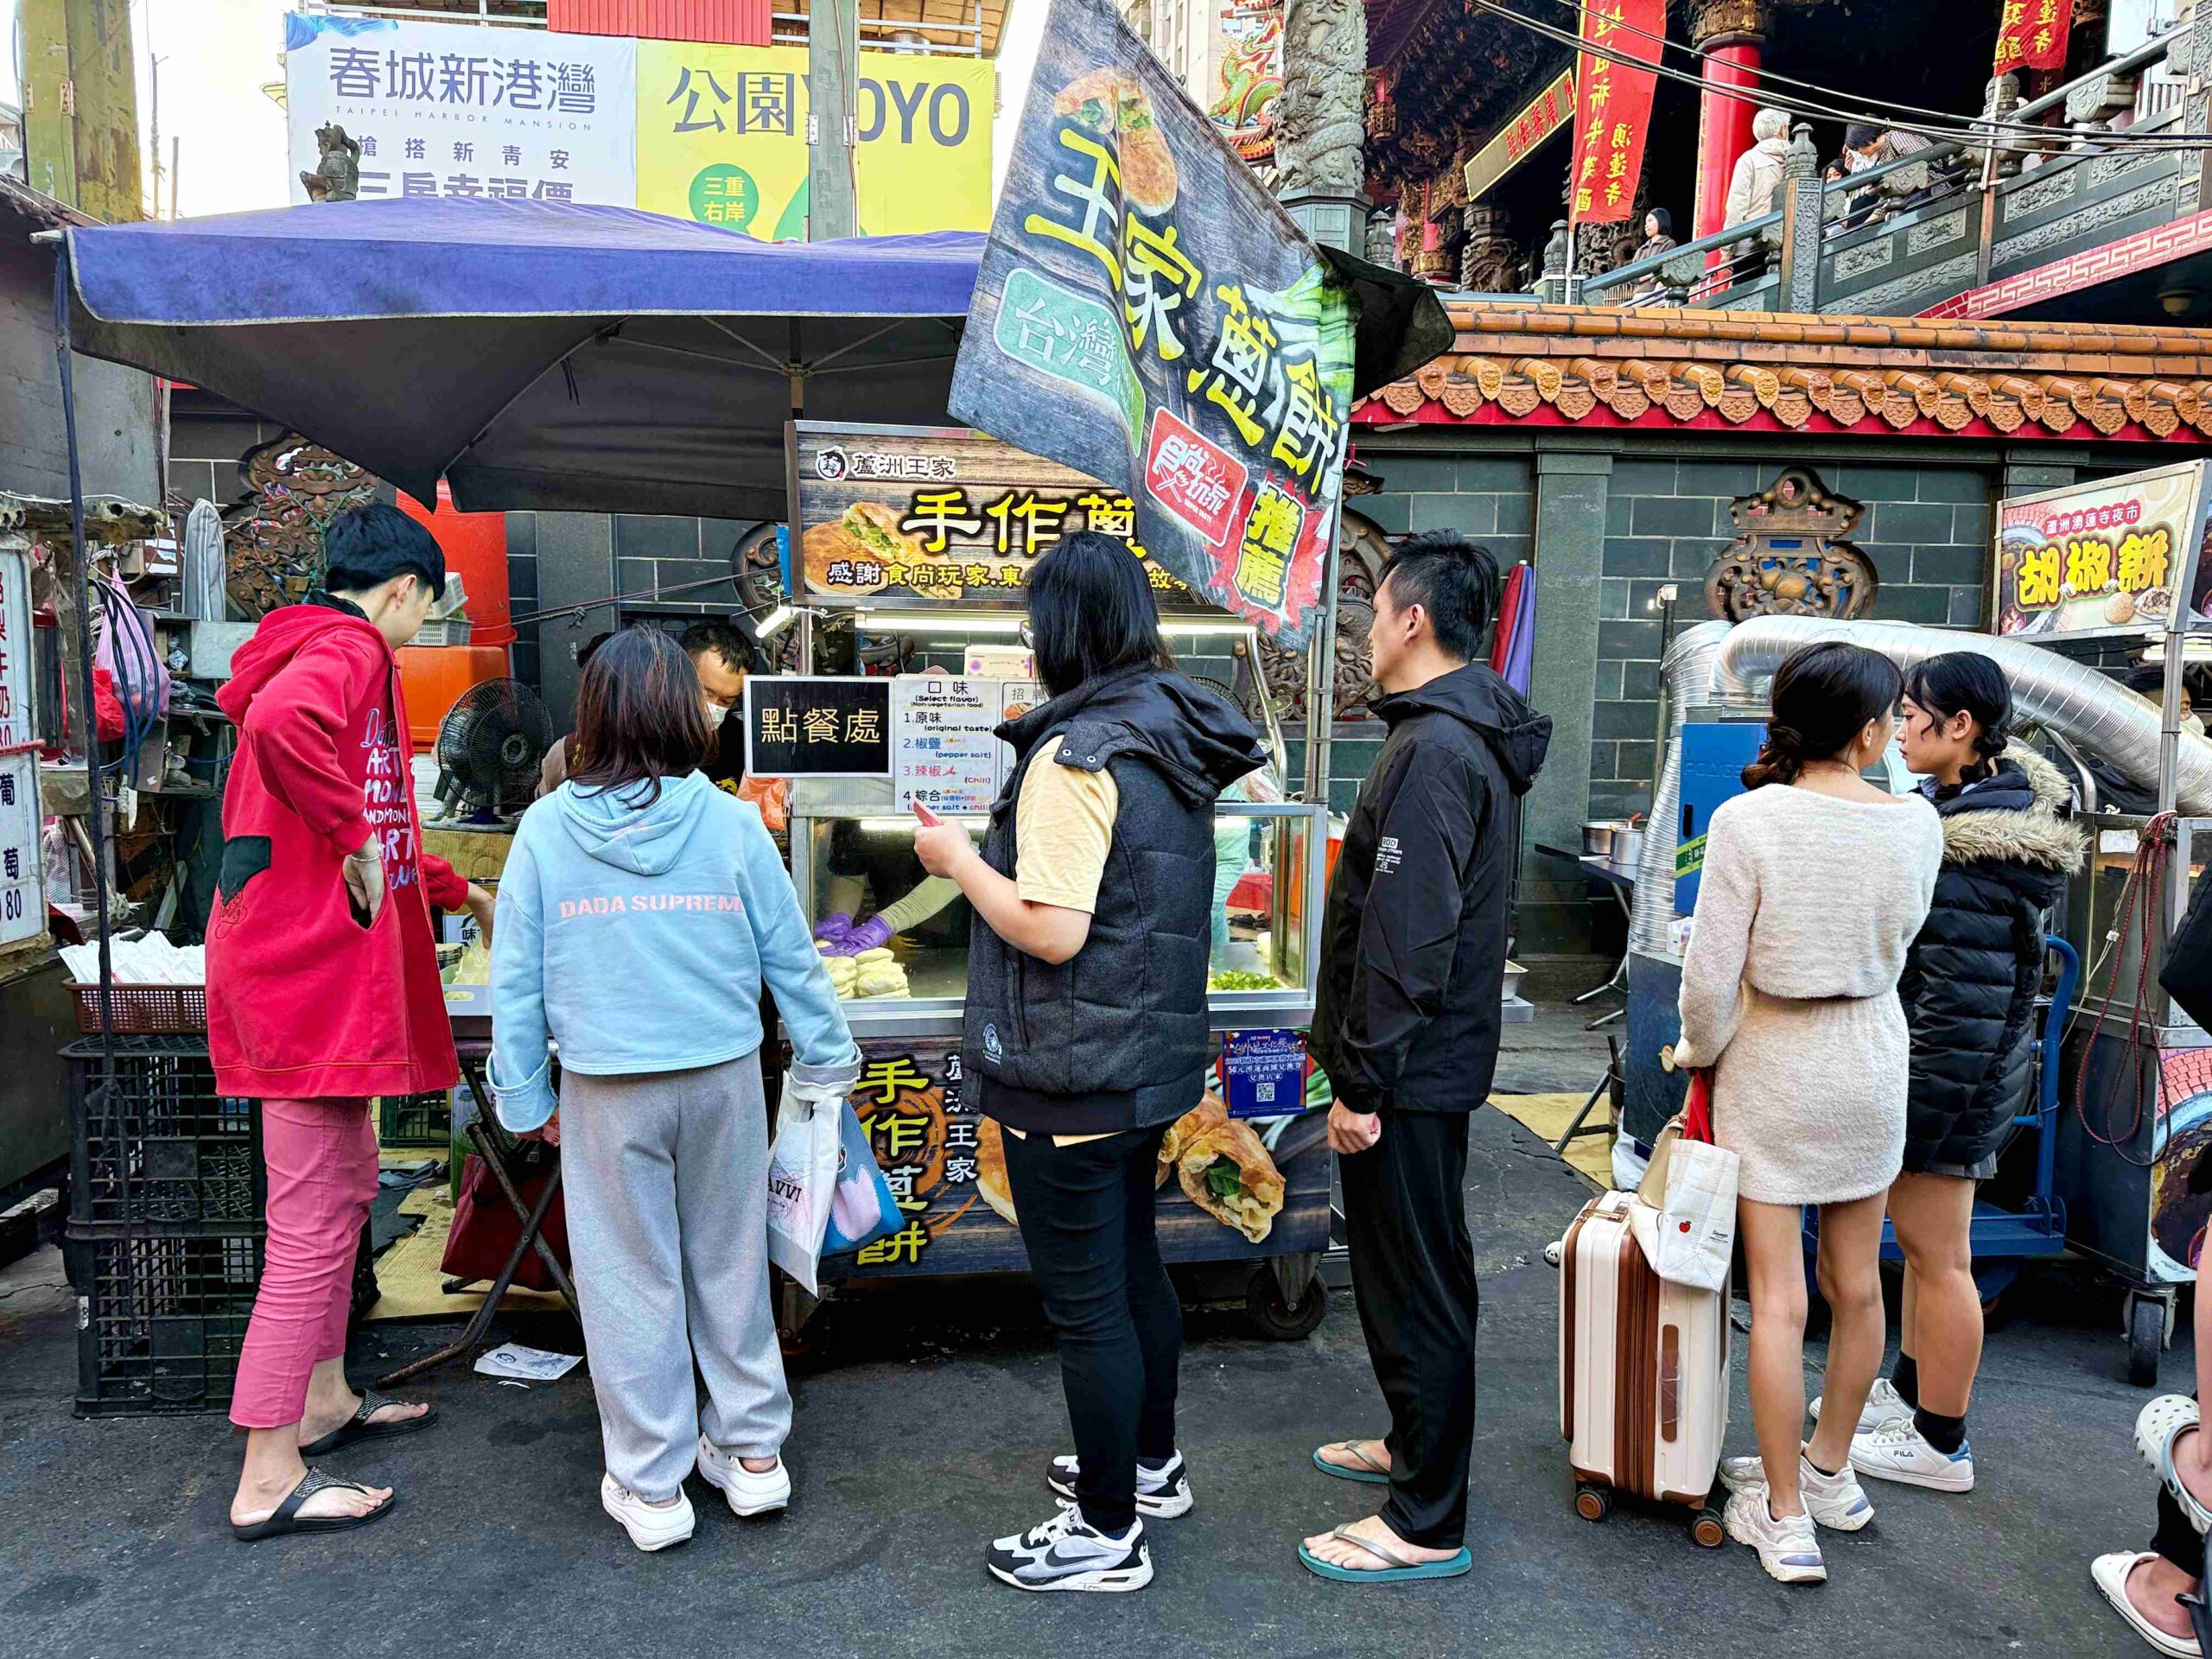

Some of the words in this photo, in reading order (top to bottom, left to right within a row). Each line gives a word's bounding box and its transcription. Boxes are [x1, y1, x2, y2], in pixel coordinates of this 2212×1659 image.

[329, 47, 595, 114] 春城新港灣
[335, 105, 399, 118] TAIPEI
[415, 111, 488, 124] HARBOR
[505, 118, 593, 131] MANSION
[703, 175, 746, 197] 三重
[703, 200, 746, 223] 右岸
[1014, 297, 1117, 387] 台灣
[854, 454, 955, 478] 蘆洲王家
[2046, 505, 2139, 535] 蘆洲湧蓮寺夜市
[2018, 530, 2169, 605] 胡椒餅
[915, 694, 947, 702] (Select
[950, 695, 979, 703] flavor)
[928, 680, 969, 696] 口味
[760, 707, 880, 744] 點餐處
[904, 711, 942, 724] 1.原味
[903, 737, 942, 750] 2.椒鹽
[935, 750, 969, 759] (pepper
[903, 764, 942, 777] 3.辣椒
[964, 776, 991, 785] (Chili)
[903, 789, 942, 802] 4綜合
[0, 772, 19, 880] 葡萄
[6, 888, 22, 922] 80
[559, 895, 627, 919] DADA
[631, 894, 746, 913] SUPREM
